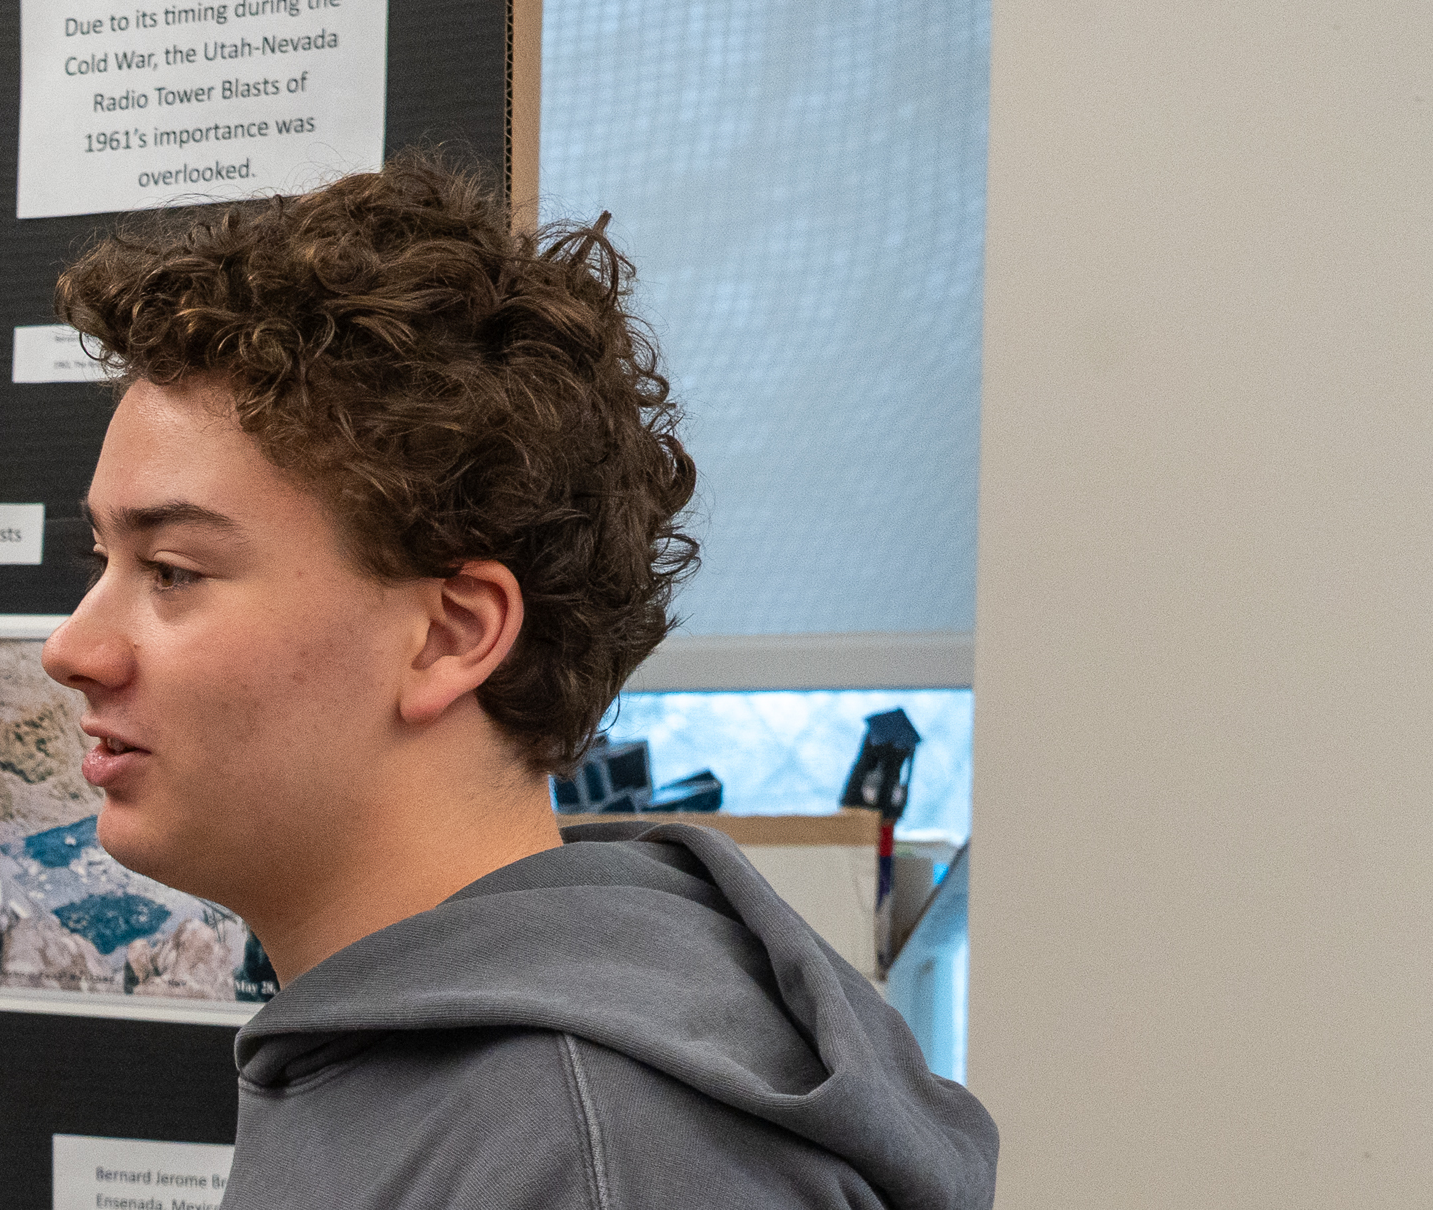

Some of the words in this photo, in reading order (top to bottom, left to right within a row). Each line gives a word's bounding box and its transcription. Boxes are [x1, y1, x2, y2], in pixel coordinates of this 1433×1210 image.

[65, 17, 103, 37] Due
[110, 15, 130, 32] to
[136, 10, 158, 29] its
[164, 3, 228, 26] timing
[234, 0, 301, 18] during
[65, 53, 108, 76] Cold
[115, 51, 158, 71] War,
[164, 45, 197, 66] the
[204, 30, 339, 61] Utah-Nevada
[94, 90, 148, 112] Radio
[155, 86, 215, 106] Tower
[222, 78, 280, 101] Blasts
[286, 70, 309, 94] of
[86, 129, 147, 153] 1961's
[154, 121, 270, 146] importance
[275, 116, 316, 135] was
[138, 159, 255, 187] overlooked.
[235, 980, 258, 996] May
[96, 1166, 152, 1185] Bernard
[156, 1171, 207, 1188] Jerome
